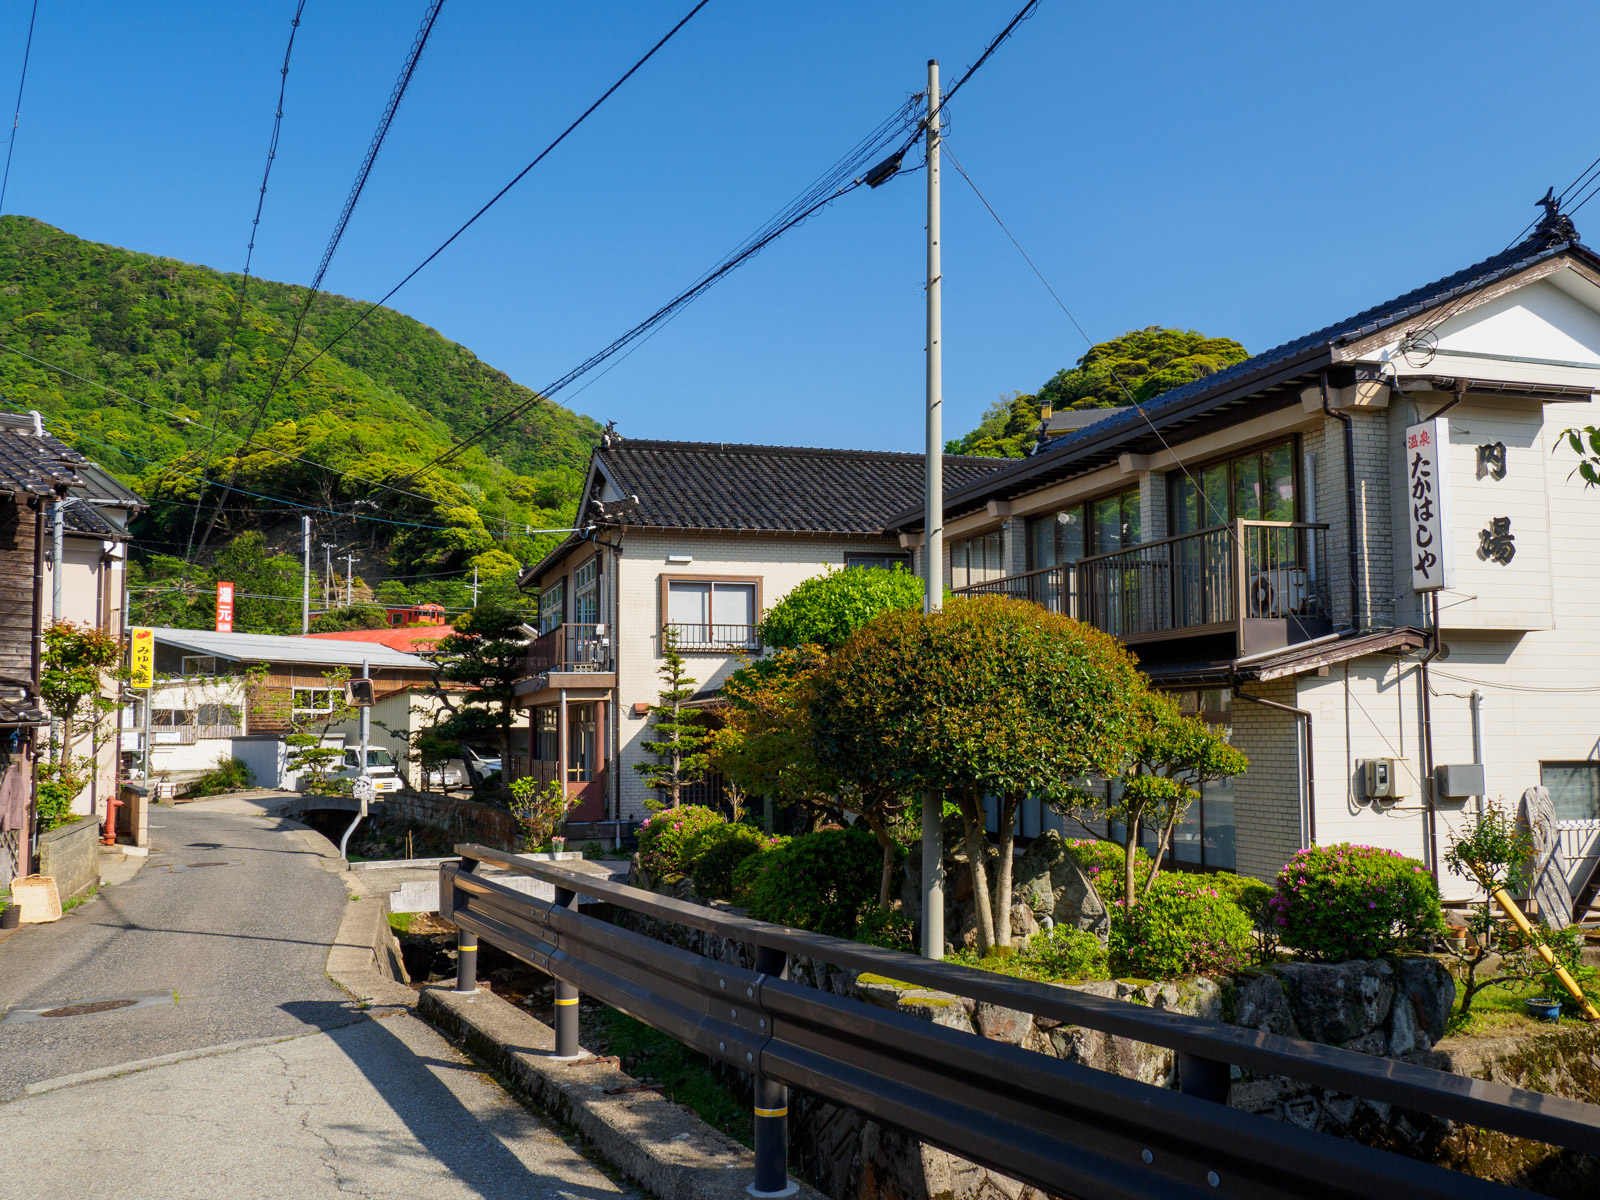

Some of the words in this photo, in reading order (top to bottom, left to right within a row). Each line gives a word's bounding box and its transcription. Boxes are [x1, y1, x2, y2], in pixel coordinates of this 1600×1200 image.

[1408, 430, 1431, 449] 温泉
[1411, 452, 1437, 579] たかはしや
[1477, 441, 1516, 565] 内湯
[218, 587, 232, 621] 湯元
